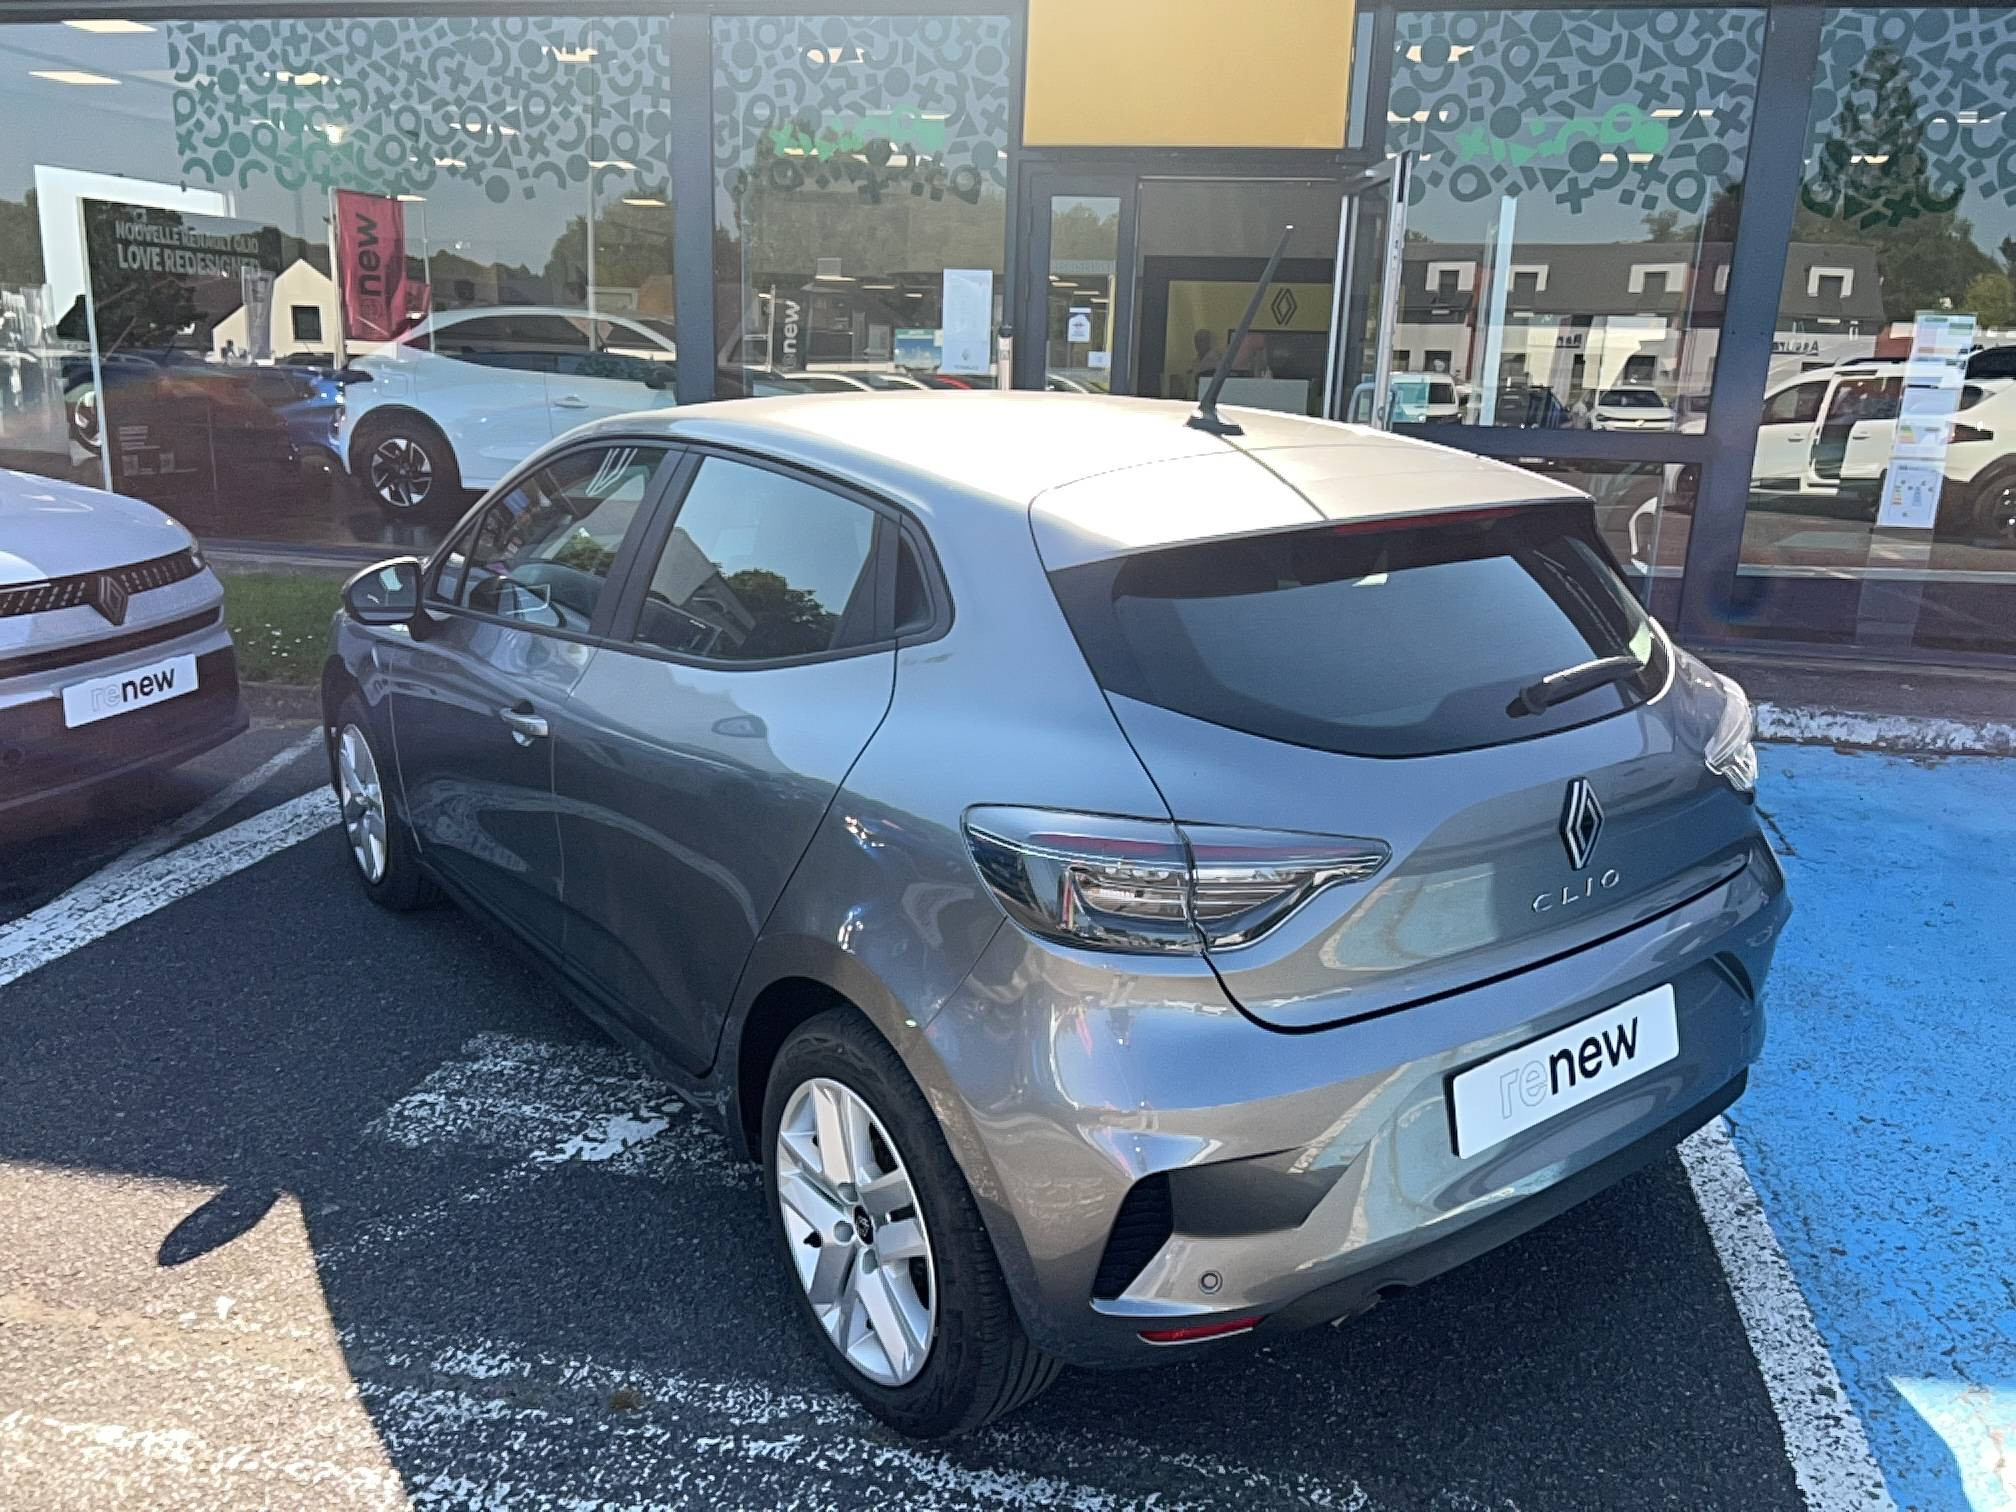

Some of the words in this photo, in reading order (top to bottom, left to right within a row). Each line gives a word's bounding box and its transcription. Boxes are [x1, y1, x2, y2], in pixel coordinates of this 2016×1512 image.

[117, 244, 162, 272] LOVE
[90, 667, 175, 712] renew
[1531, 868, 1620, 913] CLIO
[1500, 1016, 1639, 1119] renew
